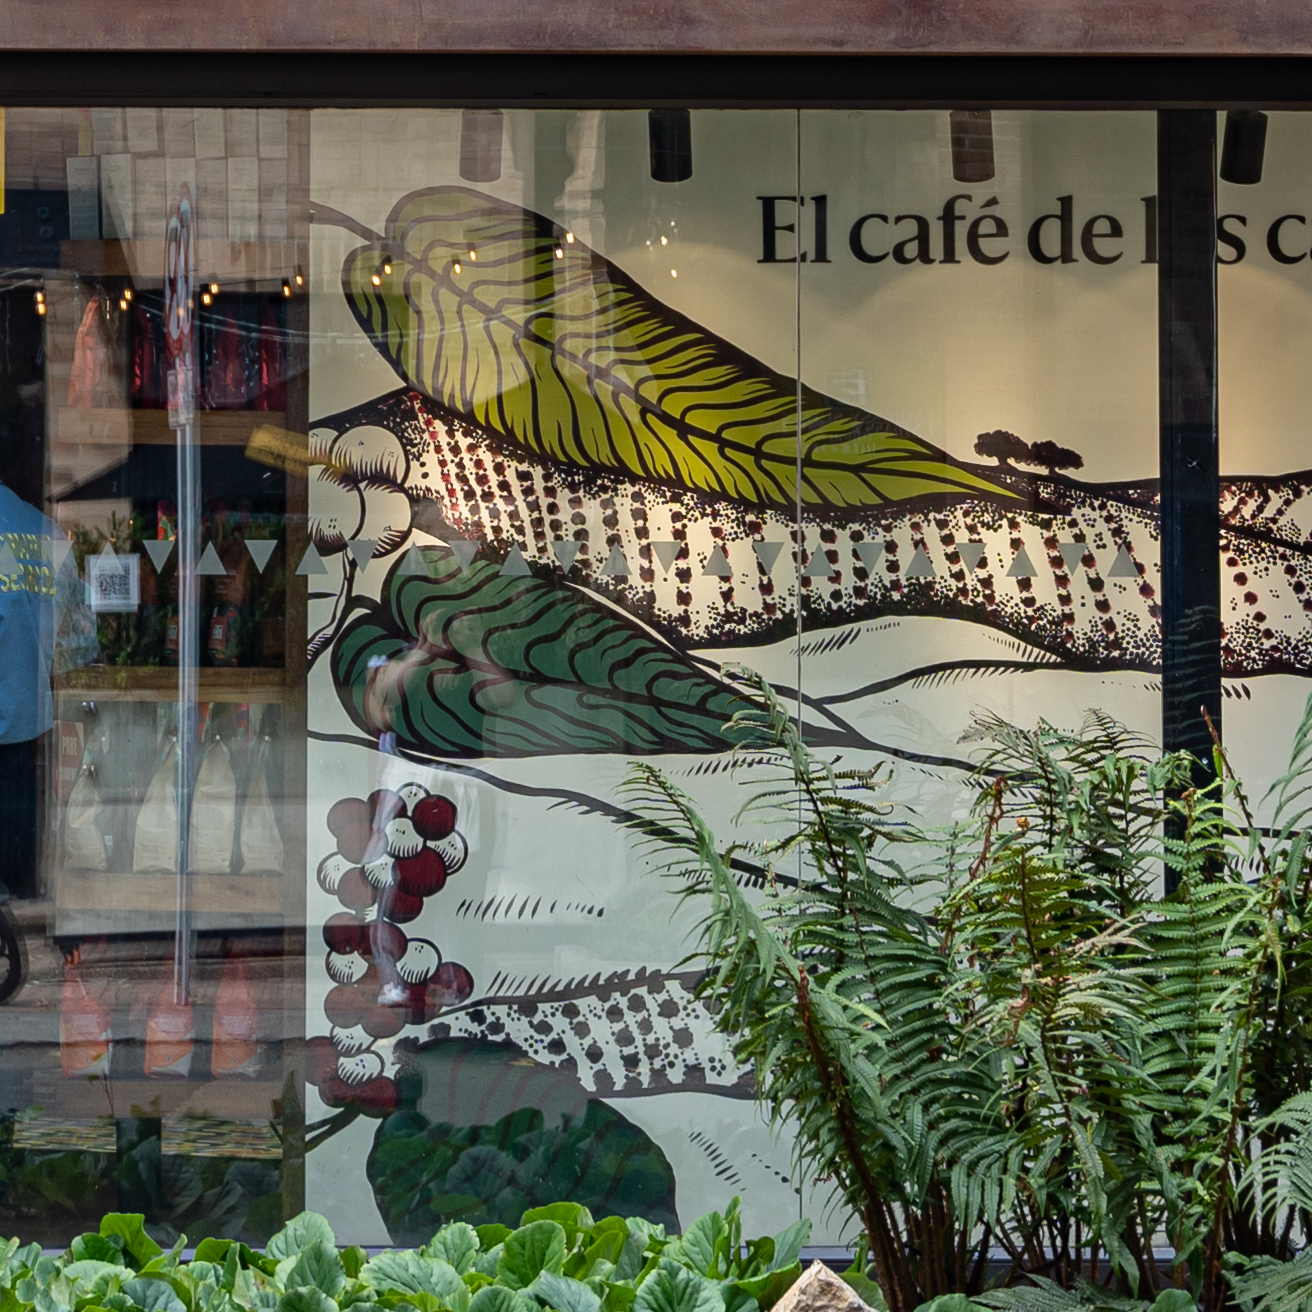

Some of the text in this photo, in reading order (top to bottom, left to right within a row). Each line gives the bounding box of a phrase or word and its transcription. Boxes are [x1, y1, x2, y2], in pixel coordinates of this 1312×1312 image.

[756, 195, 832, 264] El
[849, 194, 1010, 265] café
[1028, 195, 1124, 265] de
[1140, 195, 1249, 265] ls
